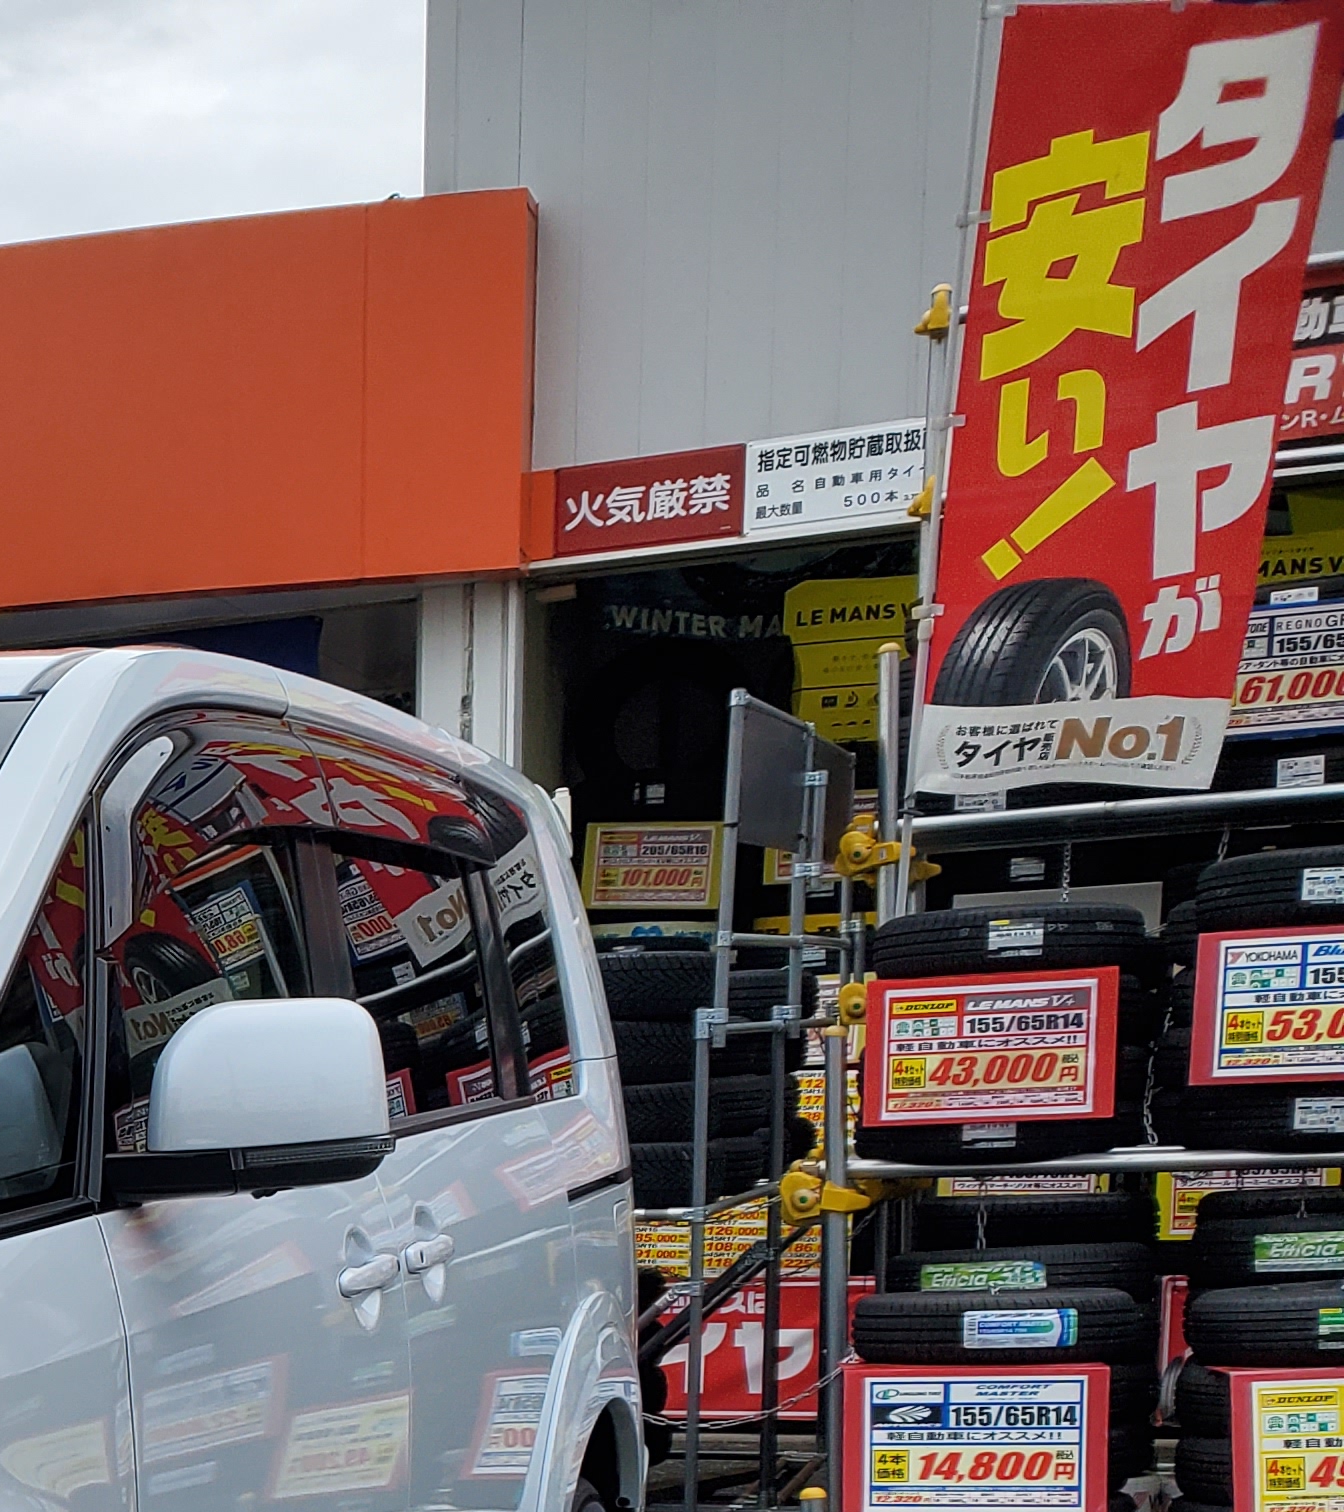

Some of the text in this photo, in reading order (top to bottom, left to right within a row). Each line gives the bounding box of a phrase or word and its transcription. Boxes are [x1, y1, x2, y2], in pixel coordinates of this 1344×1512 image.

[1126, 24, 1321, 661] タイヤが
[564, 472, 731, 532] 火気厳禁
[756, 499, 803, 520] 最大数量
[611, 605, 726, 637] WINTER
[796, 609, 823, 627] LE
[830, 603, 896, 624] MANS
[1275, 618, 1323, 631] REGNO
[955, 719, 1060, 737] お客様に選ばれて
[954, 732, 1043, 768] タイヤ
[1055, 715, 1185, 763] No.1
[620, 868, 691, 887] 101,000
[1245, 949, 1298, 963] YOKOHAMA
[904, 1002, 955, 1012] DUNLOP
[966, 1013, 1084, 1034] 155/65R14
[928, 1052, 1059, 1087] 43,000
[1275, 1395, 1334, 1404] DUNLOP
[951, 1405, 1078, 1427] 155/65R14
[877, 1468, 905, 1480] 価格
[918, 1450, 1053, 1483] 14,800
